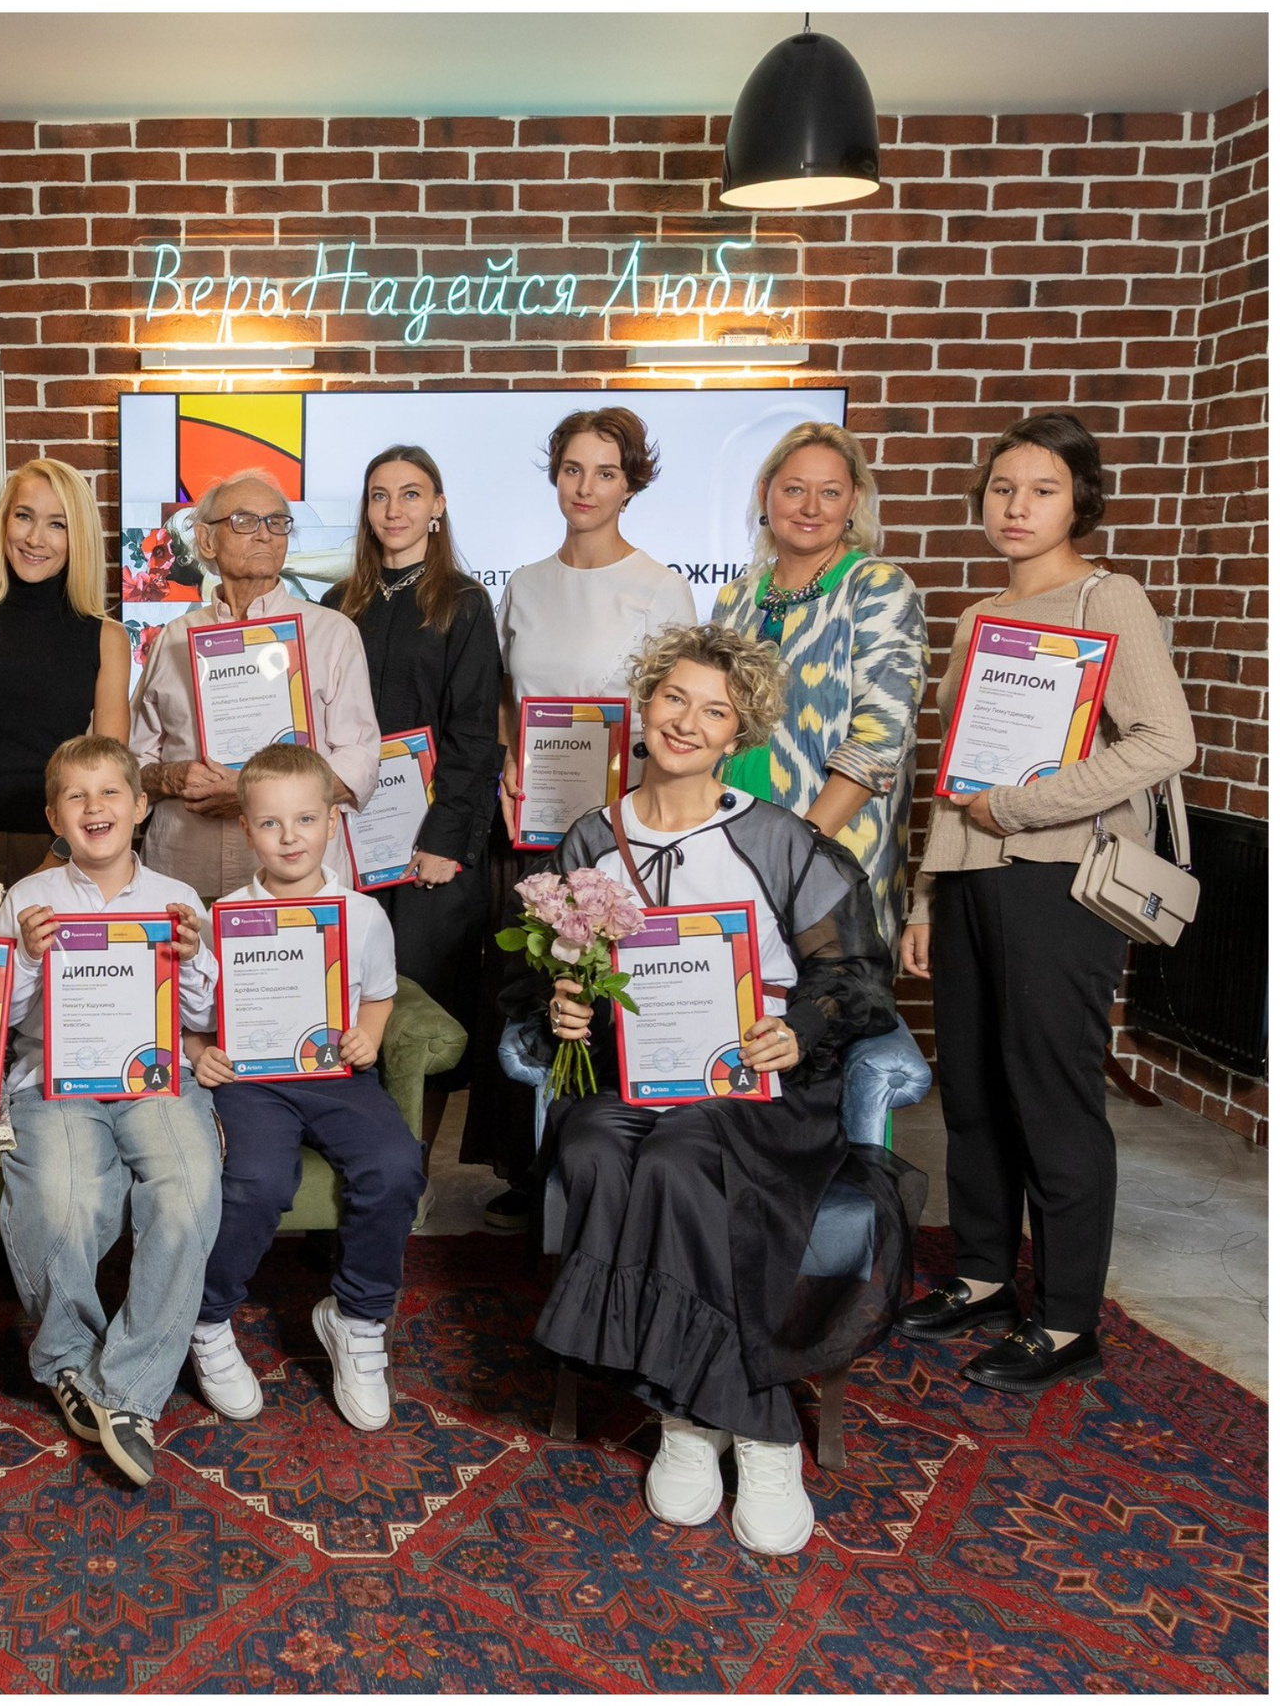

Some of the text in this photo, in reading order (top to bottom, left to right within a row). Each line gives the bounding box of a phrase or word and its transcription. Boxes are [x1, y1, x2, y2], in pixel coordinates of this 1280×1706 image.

[292, 241, 587, 346] Надейся,
[599, 240, 793, 319] Люби,
[208, 664, 260, 681] ДИПЛО
[981, 668, 1056, 692] ДИПЛОМ
[534, 739, 592, 751] ДИПЛОМ
[233, 949, 304, 966] ДИПЛОМ
[62, 965, 134, 980] ДИПЛОМ
[632, 960, 710, 978] ДИПЛОМ
